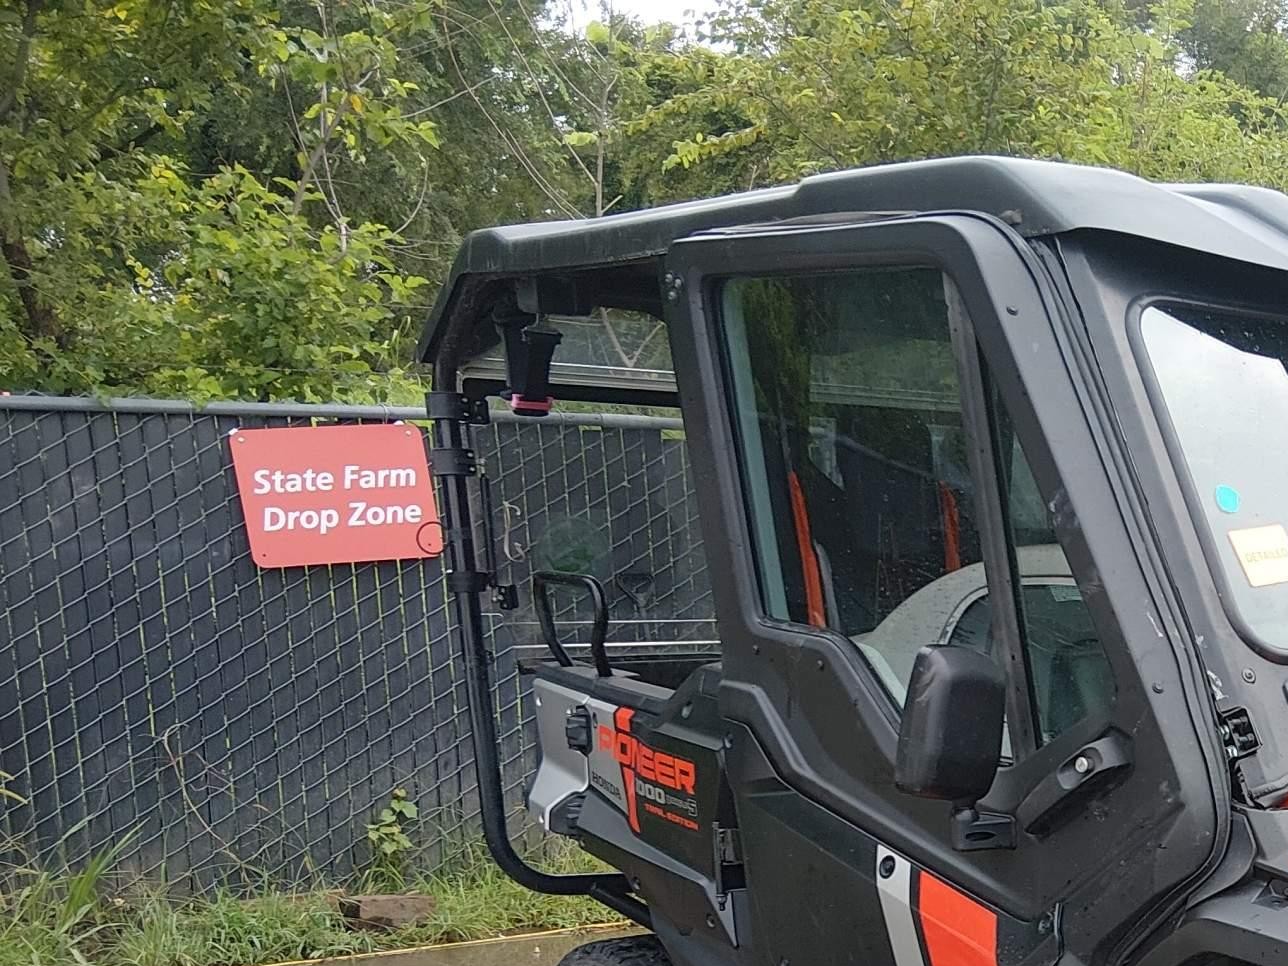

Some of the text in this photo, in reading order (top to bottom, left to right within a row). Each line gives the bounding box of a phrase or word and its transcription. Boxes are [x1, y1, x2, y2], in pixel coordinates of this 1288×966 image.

[253, 465, 416, 495] State Farm
[263, 502, 422, 534] Drop Zone
